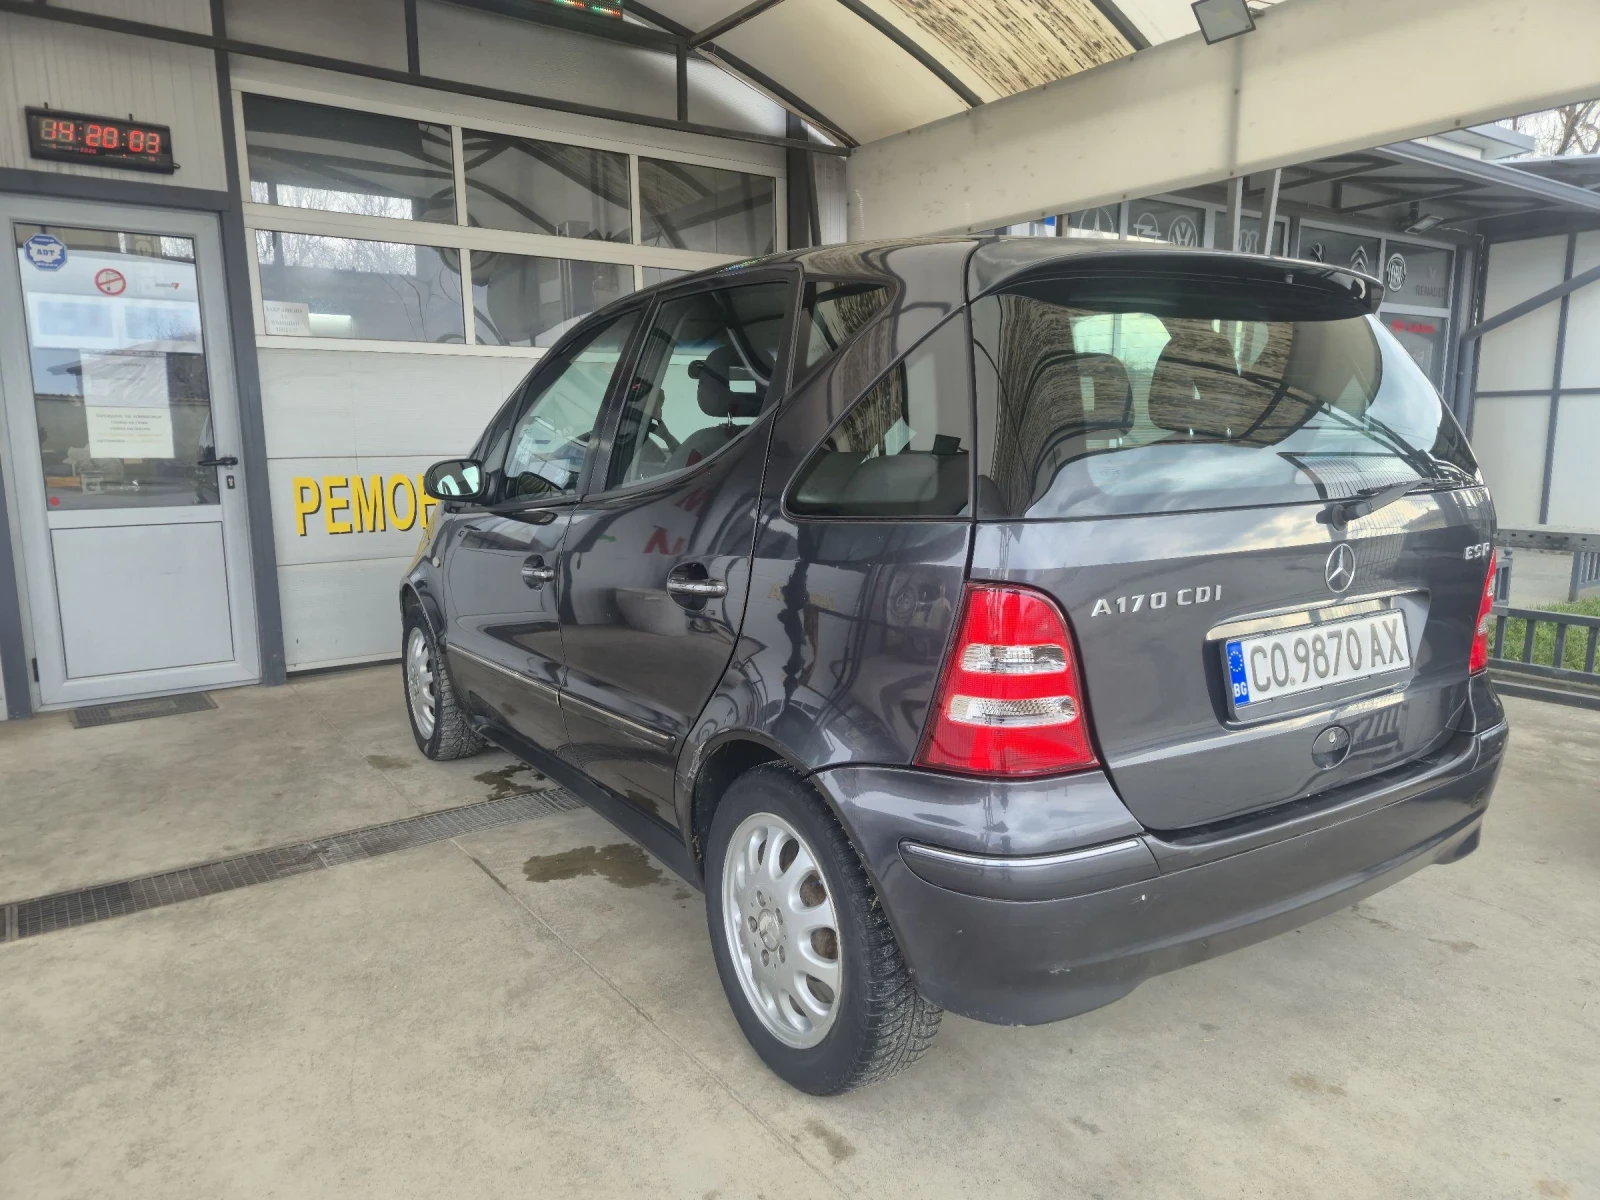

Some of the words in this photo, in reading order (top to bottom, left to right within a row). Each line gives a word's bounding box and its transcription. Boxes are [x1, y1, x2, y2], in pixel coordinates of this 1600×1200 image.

[50, 120, 160, 154] 14:20:03
[1464, 542, 1491, 561] ESP
[1176, 584, 1222, 606] CDI
[1293, 627, 1363, 684] 9870
[1233, 682, 1249, 698] BG
